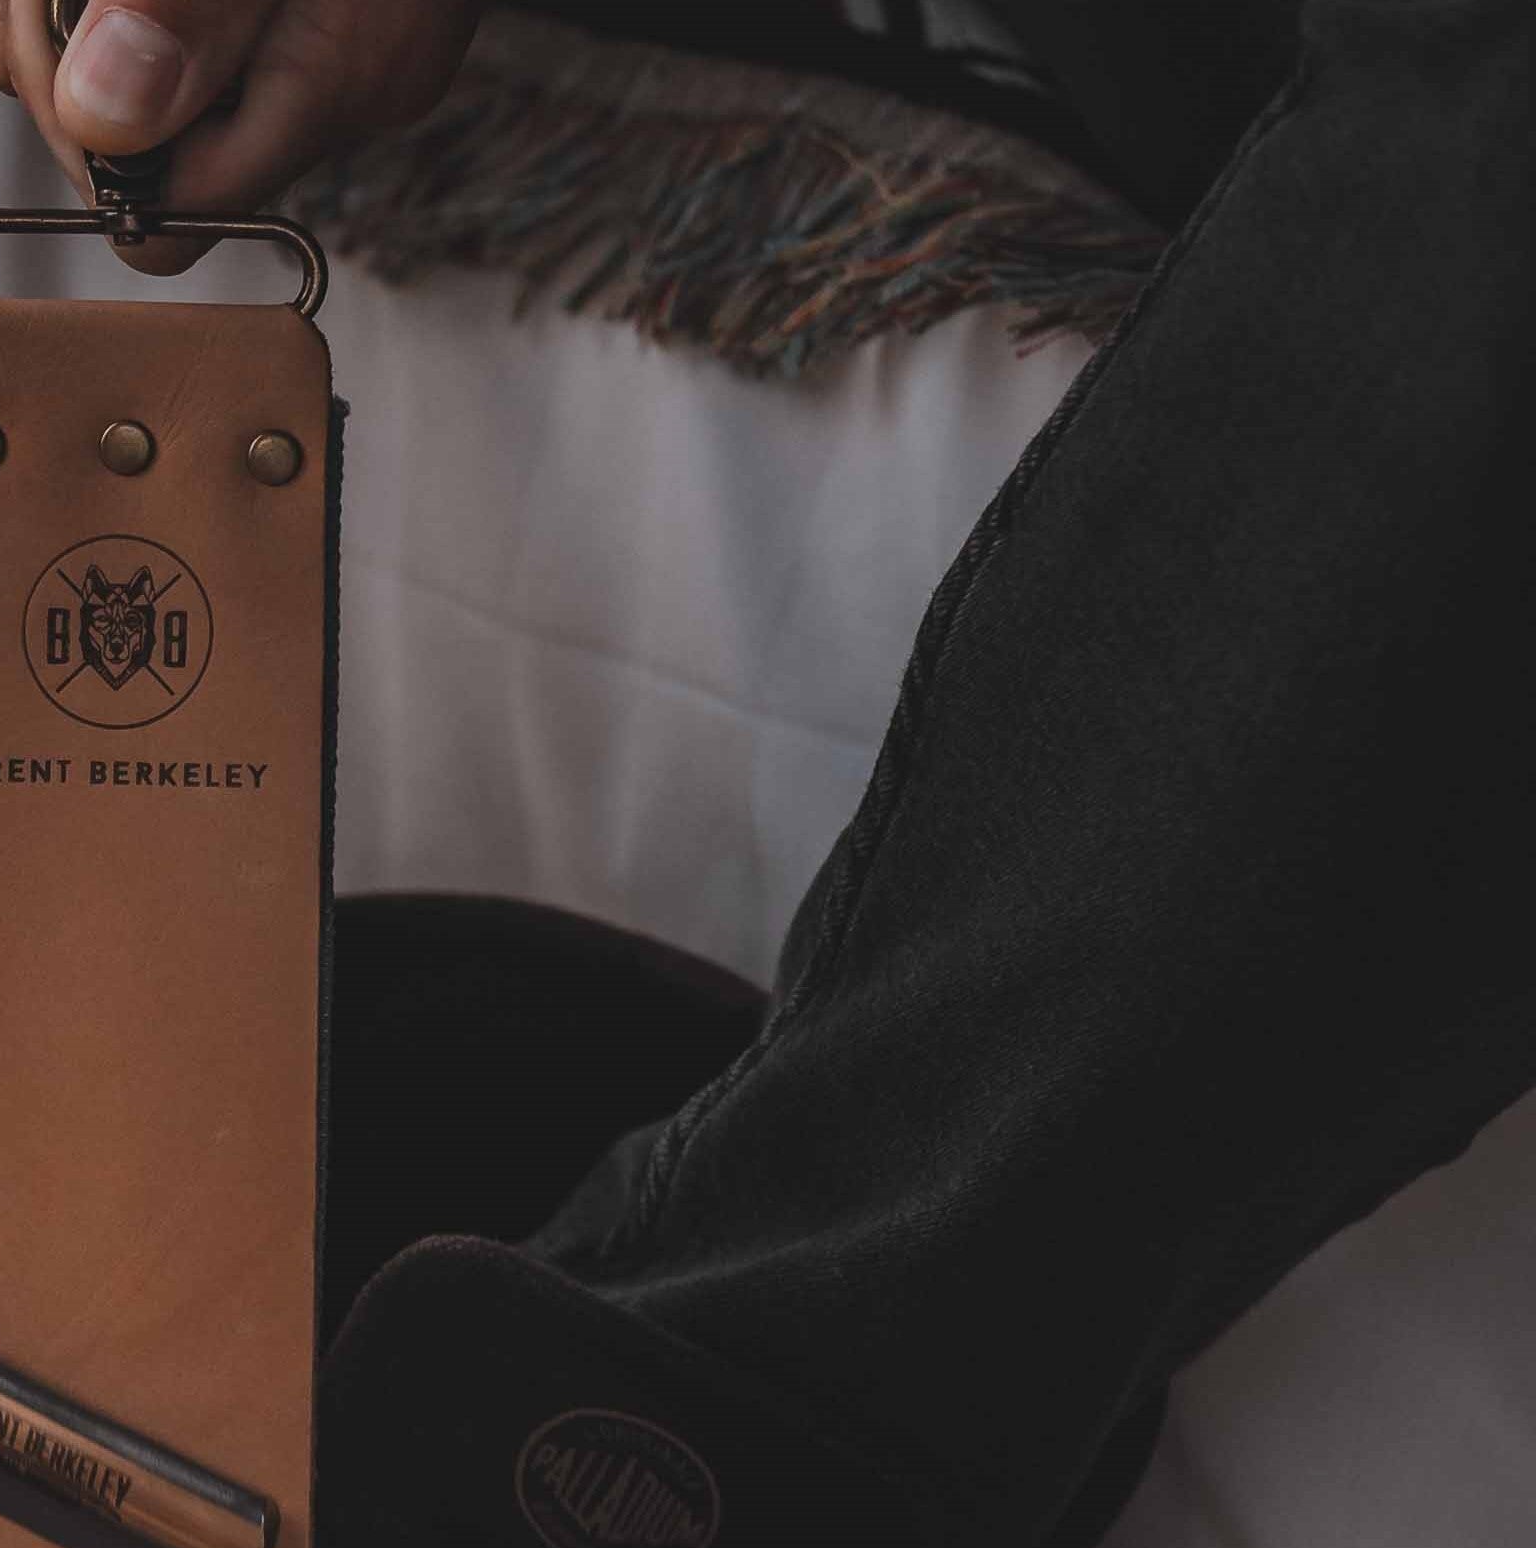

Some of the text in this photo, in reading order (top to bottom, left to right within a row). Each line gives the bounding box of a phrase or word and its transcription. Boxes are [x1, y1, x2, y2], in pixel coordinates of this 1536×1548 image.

[47, 608, 70, 664] B
[89, 761, 267, 788] BERKELEY
[528, 1442, 706, 1546] PALLADIUM
